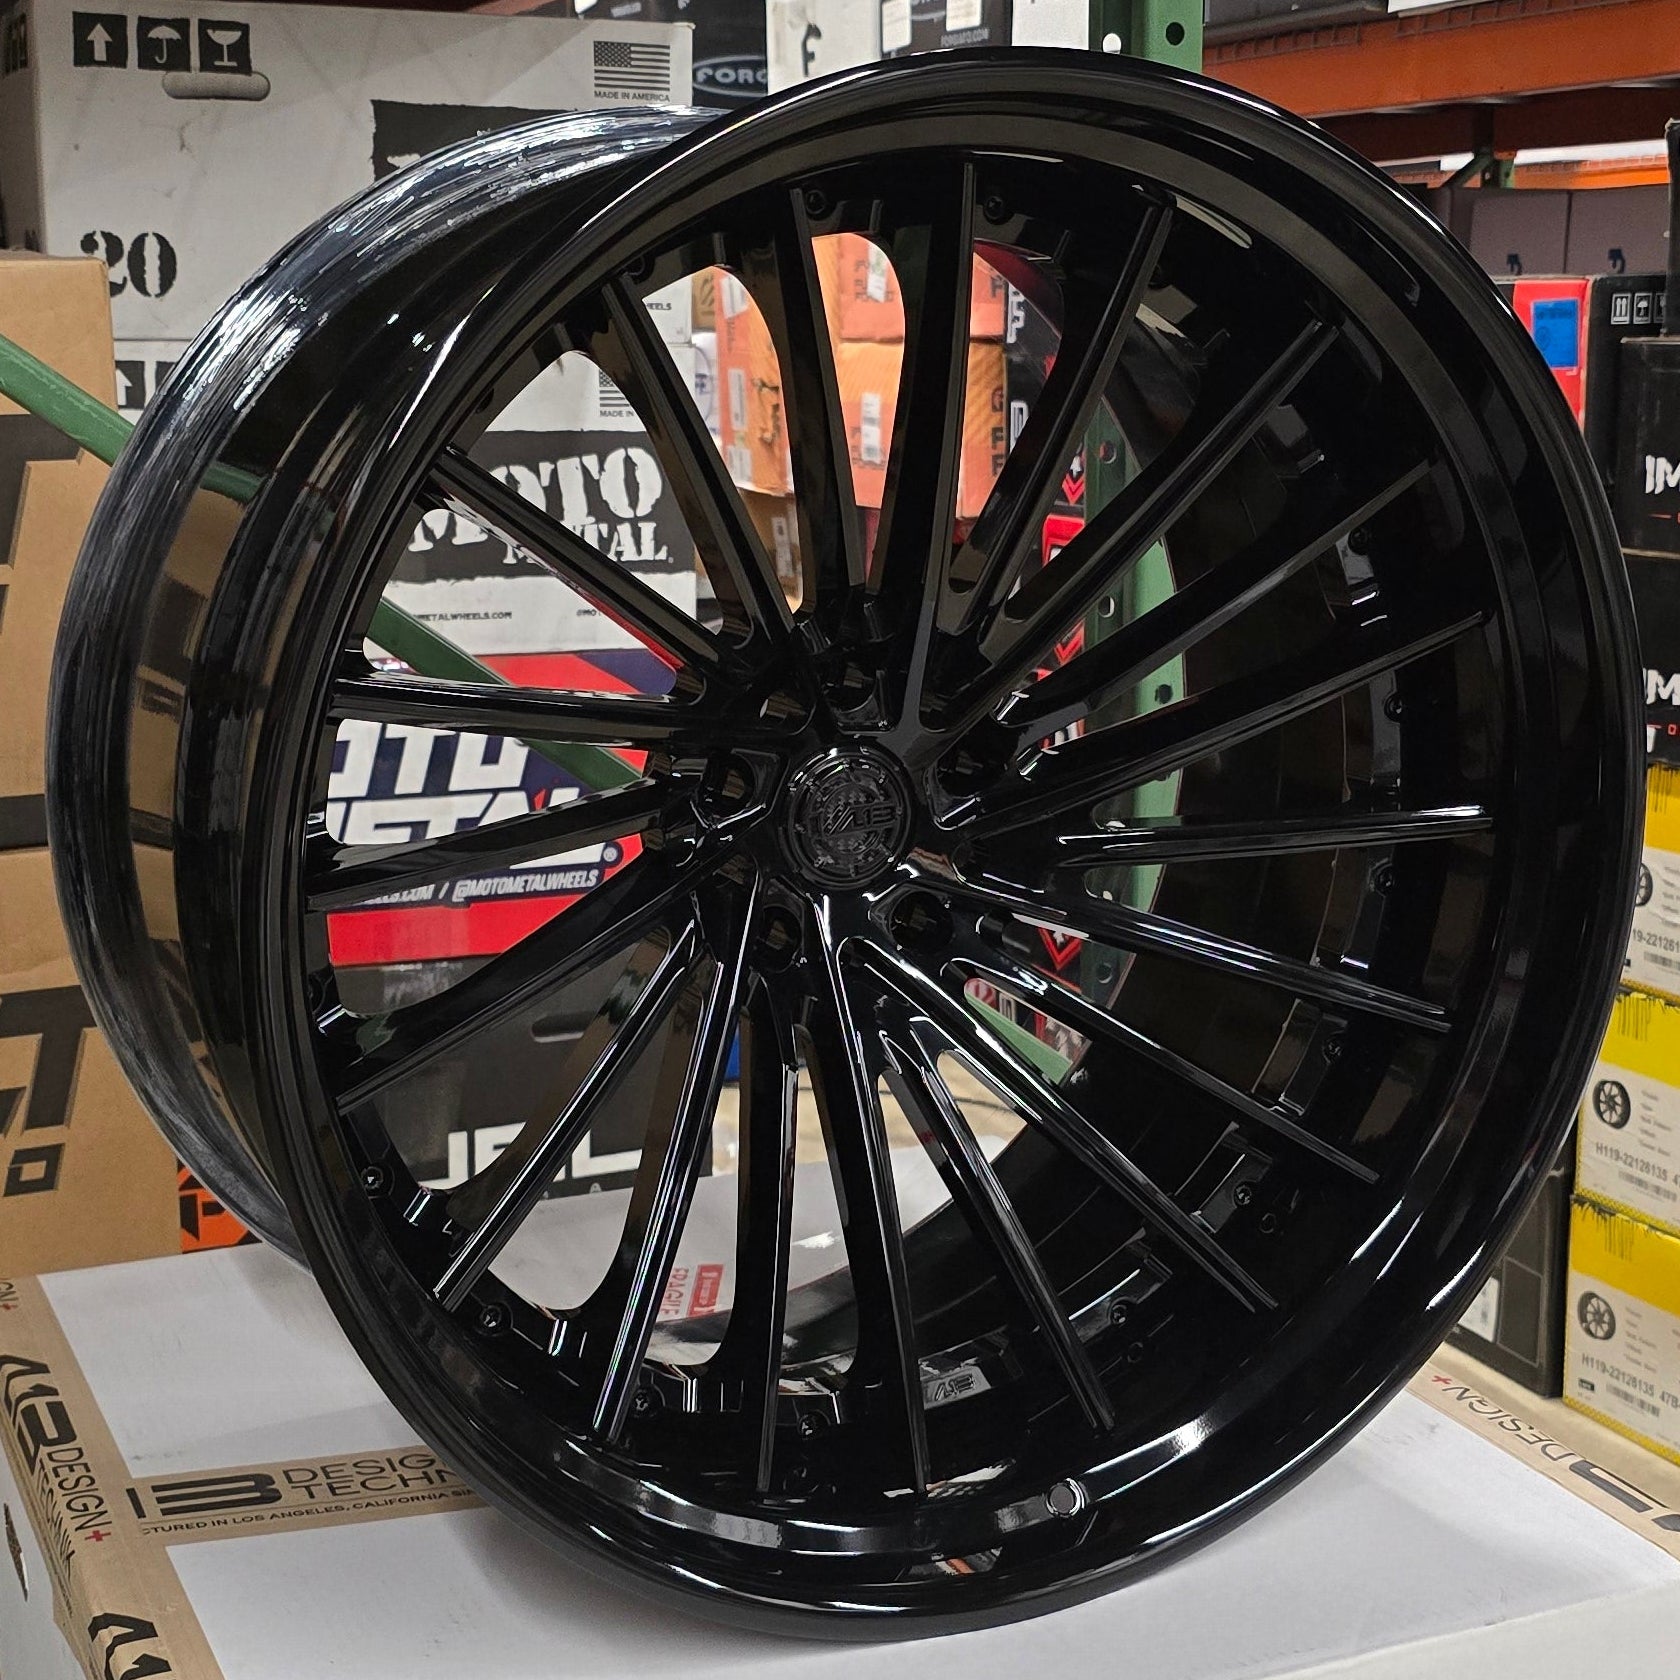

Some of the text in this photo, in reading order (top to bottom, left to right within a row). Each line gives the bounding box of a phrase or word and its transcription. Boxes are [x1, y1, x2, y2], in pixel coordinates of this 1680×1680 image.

[594, 91, 670, 102] MADE IN AMERICA
[80, 230, 178, 298] 20
[599, 410, 625, 418] MADE
[451, 868, 599, 903] @MOTOMETALWHEELS
[282, 1453, 447, 1485] DESIG
[211, 1517, 228, 1527] IN
[232, 1512, 265, 1524] LOS
[269, 1504, 349, 1521] ANGELES,
[352, 1491, 449, 1510] CALIFORNIA
